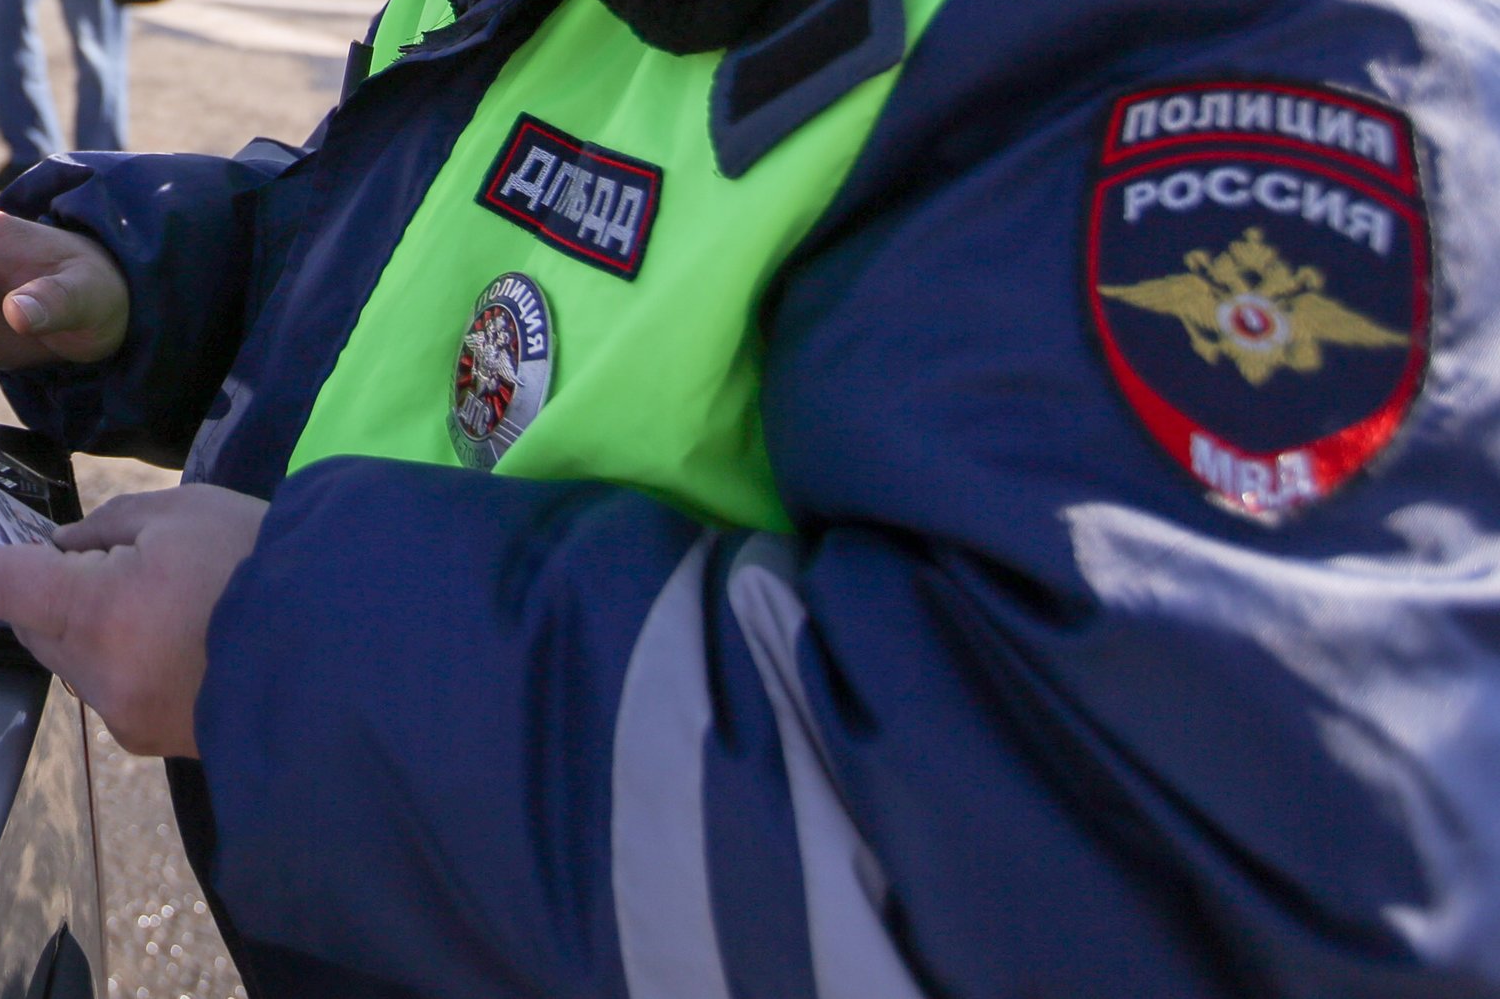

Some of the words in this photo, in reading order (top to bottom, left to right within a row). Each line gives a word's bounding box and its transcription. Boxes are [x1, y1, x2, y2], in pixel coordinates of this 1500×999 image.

[1120, 92, 1396, 166] ПОЛИЦИЯ
[1122, 166, 1392, 257] РОССИЯ
[476, 277, 545, 355] ПОЛИЦИЯ
[457, 391, 491, 436] ДПС
[1189, 431, 1313, 508] МВД
